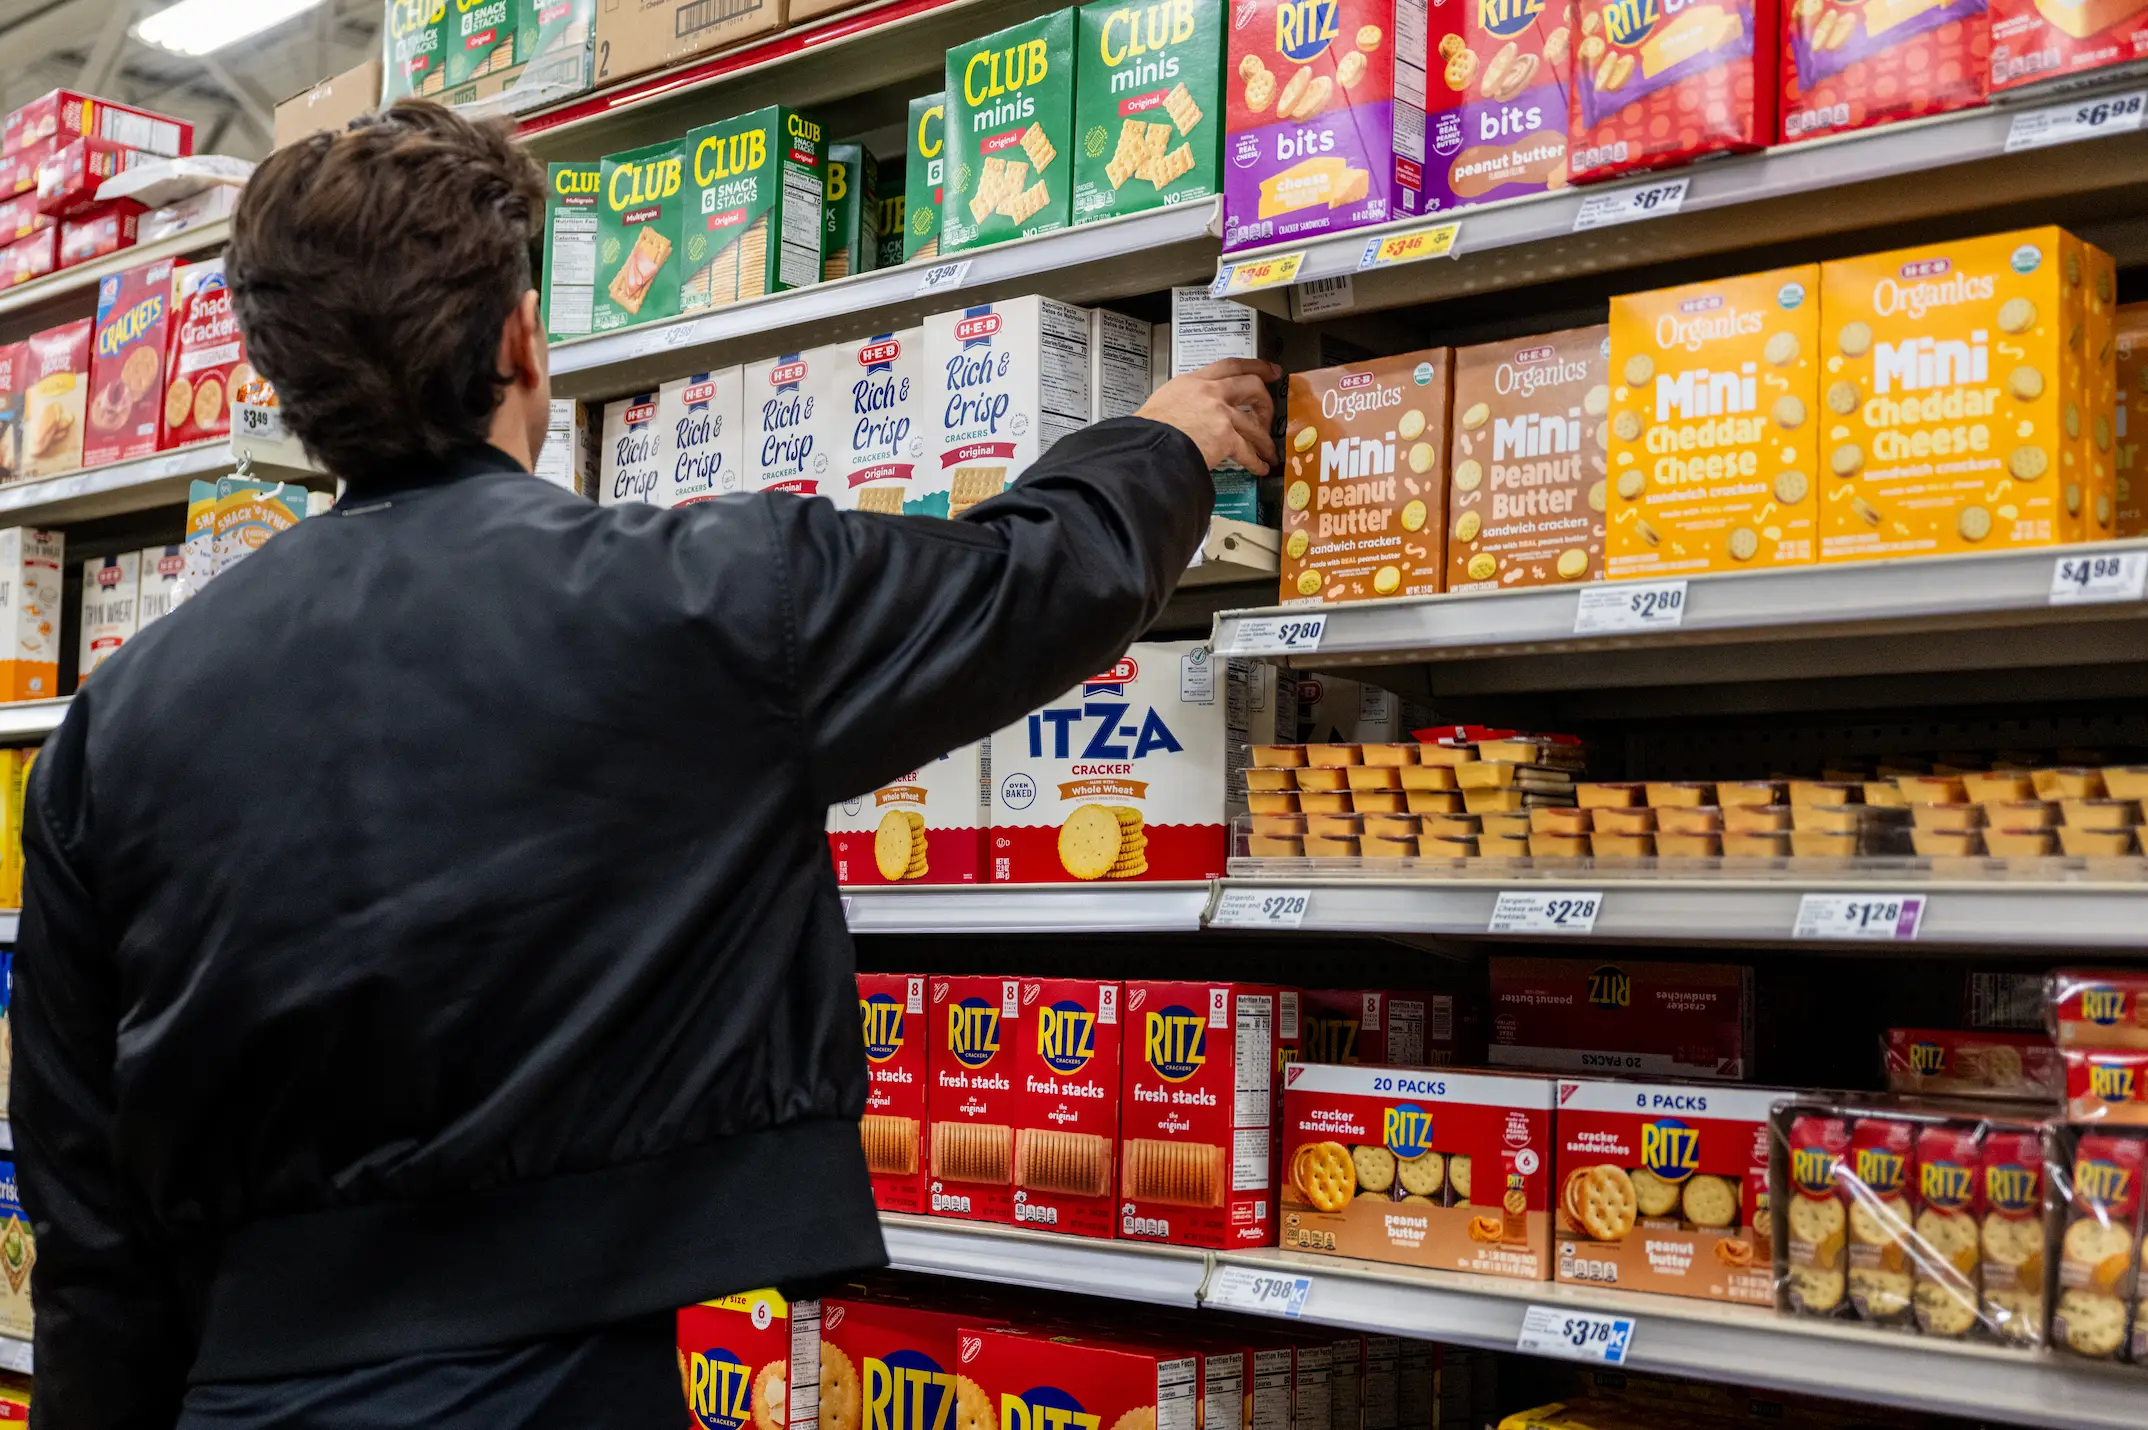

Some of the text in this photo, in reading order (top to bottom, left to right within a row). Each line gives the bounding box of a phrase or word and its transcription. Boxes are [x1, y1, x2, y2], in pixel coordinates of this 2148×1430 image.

[1101, 0, 1194, 67] CLUB
[1276, 0, 1339, 52] RITZ
[599, 40, 610, 77] 2
[964, 39, 1048, 107] CLUB
[1111, 54, 1180, 94] minis
[973, 91, 1035, 132] minis
[1128, 95, 1159, 111] Original
[2076, 97, 2141, 126] $698
[788, 113, 821, 142] CLUB
[1439, 126, 1458, 135] REAL
[1481, 106, 1542, 140] bits
[989, 134, 1017, 149] Original
[1277, 129, 1335, 161] bits
[694, 128, 766, 187] CLUB
[1455, 145, 1565, 182] peanut butter
[931, 164, 940, 179] 6
[608, 159, 681, 211] CLUB
[704, 176, 758, 206] 6 SNACK
[1633, 184, 1682, 209] $672
[716, 189, 758, 211] STACKS
[1164, 192, 1180, 206] NO
[626, 210, 657, 223] Multigrain
[1279, 218, 1330, 235] CRACKER SANDWICHES
[926, 264, 956, 285] $398
[191, 289, 231, 321] Snack
[1873, 271, 1994, 320] Organics
[1656, 307, 1763, 352] Organics
[945, 351, 1010, 391] Rich &
[1874, 329, 1989, 394] Mini
[1495, 357, 1586, 397] Organics
[852, 376, 910, 414] Rich &
[1322, 384, 1401, 421] Organics
[1656, 362, 1757, 422] Mini
[762, 396, 814, 432] Rich &
[944, 392, 1010, 434] Crisp
[1863, 388, 2000, 427] Cheddar
[676, 415, 722, 449] Rich &
[852, 416, 910, 457] Crisp
[945, 429, 988, 443] CRACKERS
[1493, 407, 1581, 462] Mini
[1646, 416, 1768, 454] Cheddar
[1873, 424, 1989, 460] Cheese
[616, 434, 649, 467] Rich
[761, 433, 814, 472] Crisp
[852, 451, 891, 464] CRACKERS
[959, 444, 994, 459] Original
[1320, 431, 1396, 483] Mini
[675, 451, 722, 488] Crisp
[762, 468, 797, 480] CRACKERS
[864, 466, 896, 480] Original
[1490, 454, 1581, 491] Peanut
[1654, 451, 1757, 485] Cheese
[614, 469, 658, 504] Crisp
[1317, 476, 1396, 511] Peanut
[1646, 481, 1768, 505] sandwich crackers
[1492, 488, 1578, 520] Butter
[1318, 508, 1392, 538] Butter
[1483, 517, 1588, 538] sandwich crackers
[1310, 536, 1401, 555] sandwich crackers
[2061, 558, 2120, 586] $498
[1631, 590, 1682, 617] $280
[1279, 622, 1321, 645] $280
[1028, 703, 1184, 760] ITZ-A
[1072, 764, 1131, 775] CRACKER
[882, 792, 919, 802] Whole Wheat
[1005, 789, 1032, 798] BAKED
[1072, 784, 1133, 795] Whole Wheat
[1262, 897, 1305, 919] $228
[1546, 900, 1595, 924] $228
[1845, 903, 1898, 927] $128
[912, 983, 919, 996] 8
[1104, 991, 1112, 1005] 8
[1214, 994, 1223, 1008] 8
[1656, 991, 1717, 1002] sandwiches
[1667, 1002, 1706, 1011] cracker
[2081, 987, 2125, 1021] RITZ
[859, 999, 905, 1047] RITZ
[948, 1003, 1000, 1054] RITZ
[1037, 1006, 1096, 1059] RITZ
[1145, 1012, 1206, 1065] RITZ
[1056, 1057, 1081, 1065] CRACKERS
[1582, 1054, 1641, 1068] 20 PACKS
[1910, 1043, 1946, 1071] RITZ
[876, 1067, 913, 1083] stacks
[939, 1070, 1010, 1090] fresh stacks
[1027, 1075, 1104, 1099] fresh stacks
[1373, 1078, 1446, 1095] 20 PACKS
[2090, 1067, 2134, 1098] RITZ
[866, 1096, 891, 1108] original
[1134, 1084, 1216, 1106] fresh stacks
[1636, 1094, 1707, 1111] 8 PACKS
[960, 1103, 987, 1116] original
[1048, 1111, 1078, 1124] original
[1311, 1109, 1354, 1122] cracker
[1158, 1119, 1190, 1134] original
[1299, 1120, 1365, 1135] sandwiches
[1383, 1108, 1433, 1149] RITZ
[1578, 1131, 1619, 1144] cracker
[1567, 1141, 1630, 1156] sandwiches
[1641, 1122, 1700, 1169] RITZ
[1857, 1151, 1904, 1186] RITZ
[1921, 1162, 1972, 1200] RITZ
[1986, 1165, 2037, 1201] RITZ
[2074, 1166, 2129, 1202] RITZ
[1385, 1215, 1428, 1230] peanut
[1388, 1227, 1426, 1241] butter
[1645, 1240, 1694, 1257] peanut
[1649, 1254, 1692, 1268] butter
[730, 1294, 747, 1305] size
[1252, 1278, 1293, 1302] $798
[758, 1305, 765, 1319] 6
[1563, 1318, 1610, 1346] $378
[1159, 1359, 1195, 1372] Nutrition Facts
[1206, 1354, 1242, 1366] Nutrition Facts
[1255, 1350, 1291, 1361] Nutrition Facts
[690, 1352, 752, 1421] RITZ
[863, 1356, 958, 1430] RITZ
[1159, 1385, 1195, 1399] Calories 80
[1206, 1380, 1242, 1393] Calories 80
[709, 1417, 737, 1428] CRACKERS
